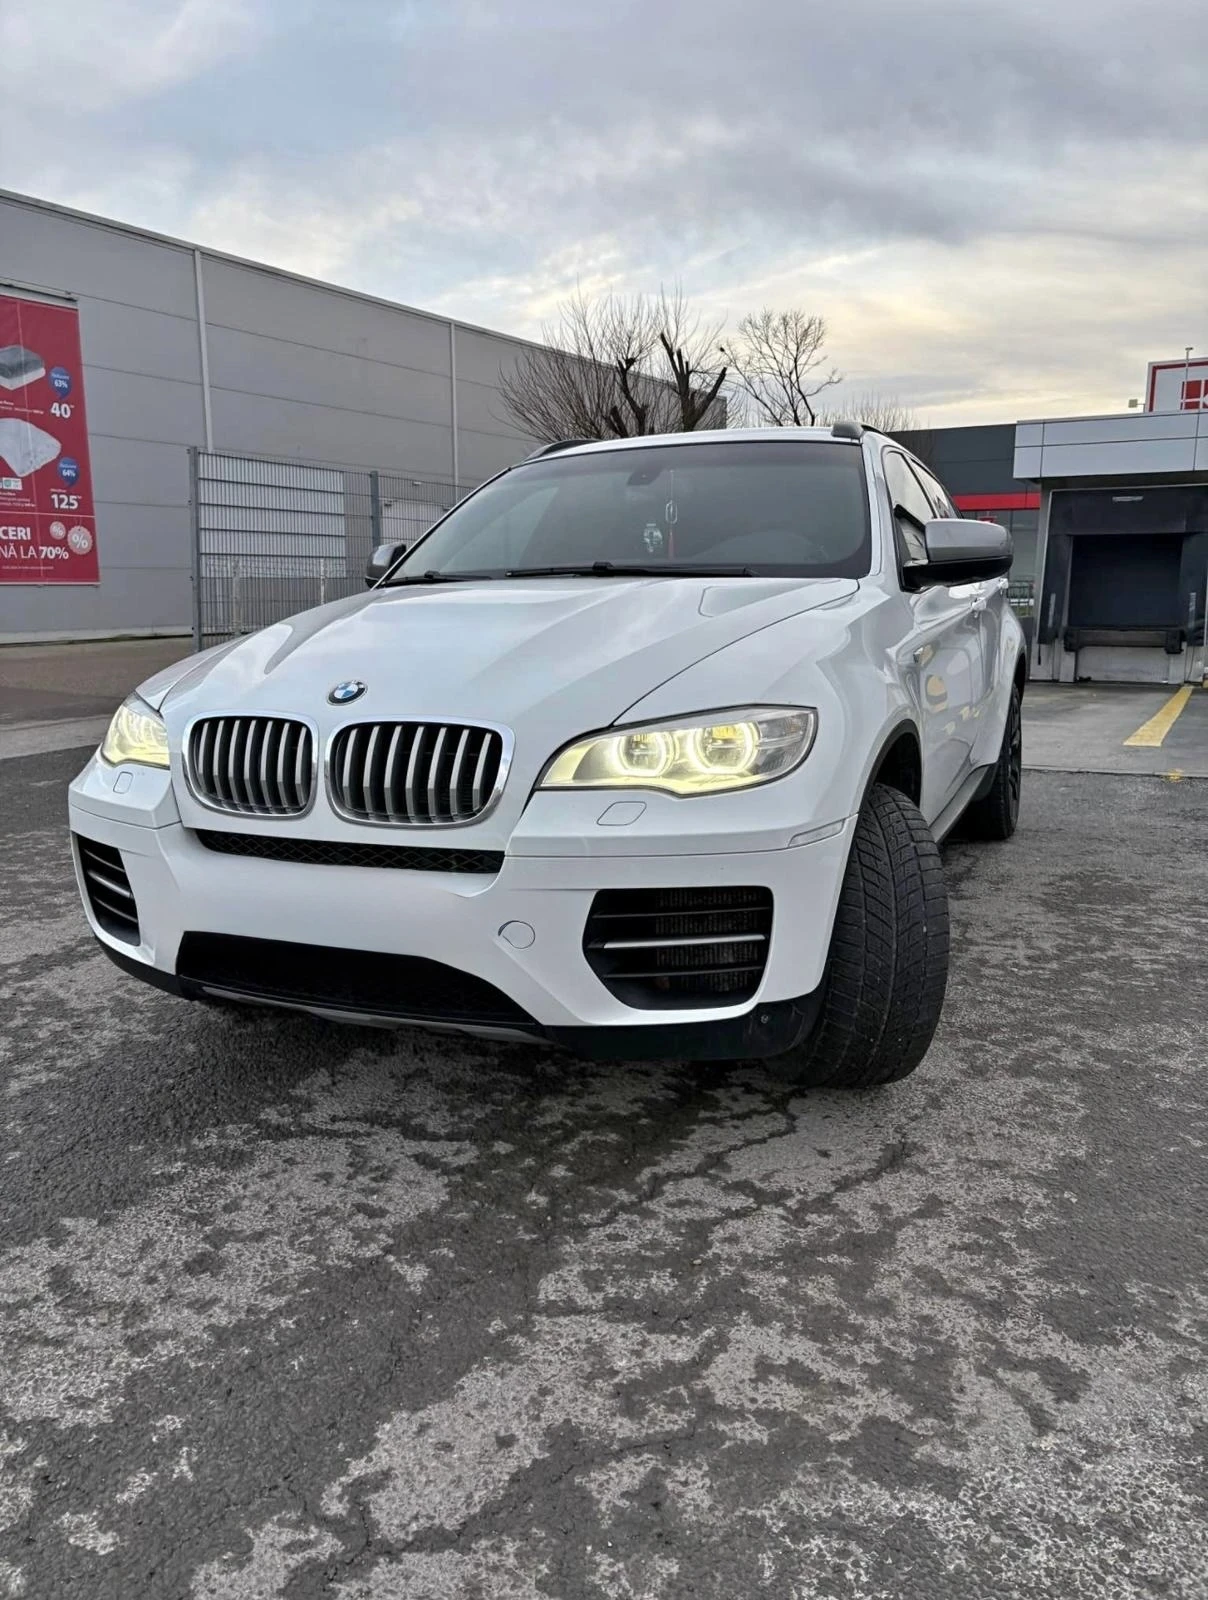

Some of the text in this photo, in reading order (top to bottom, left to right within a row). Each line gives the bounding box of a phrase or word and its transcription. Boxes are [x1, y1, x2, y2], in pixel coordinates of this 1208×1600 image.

[50, 402, 71, 418] 40
[51, 494, 79, 509] 125
[0, 526, 31, 540] CERI
[20, 545, 37, 559] LA
[39, 546, 69, 560] 70%
